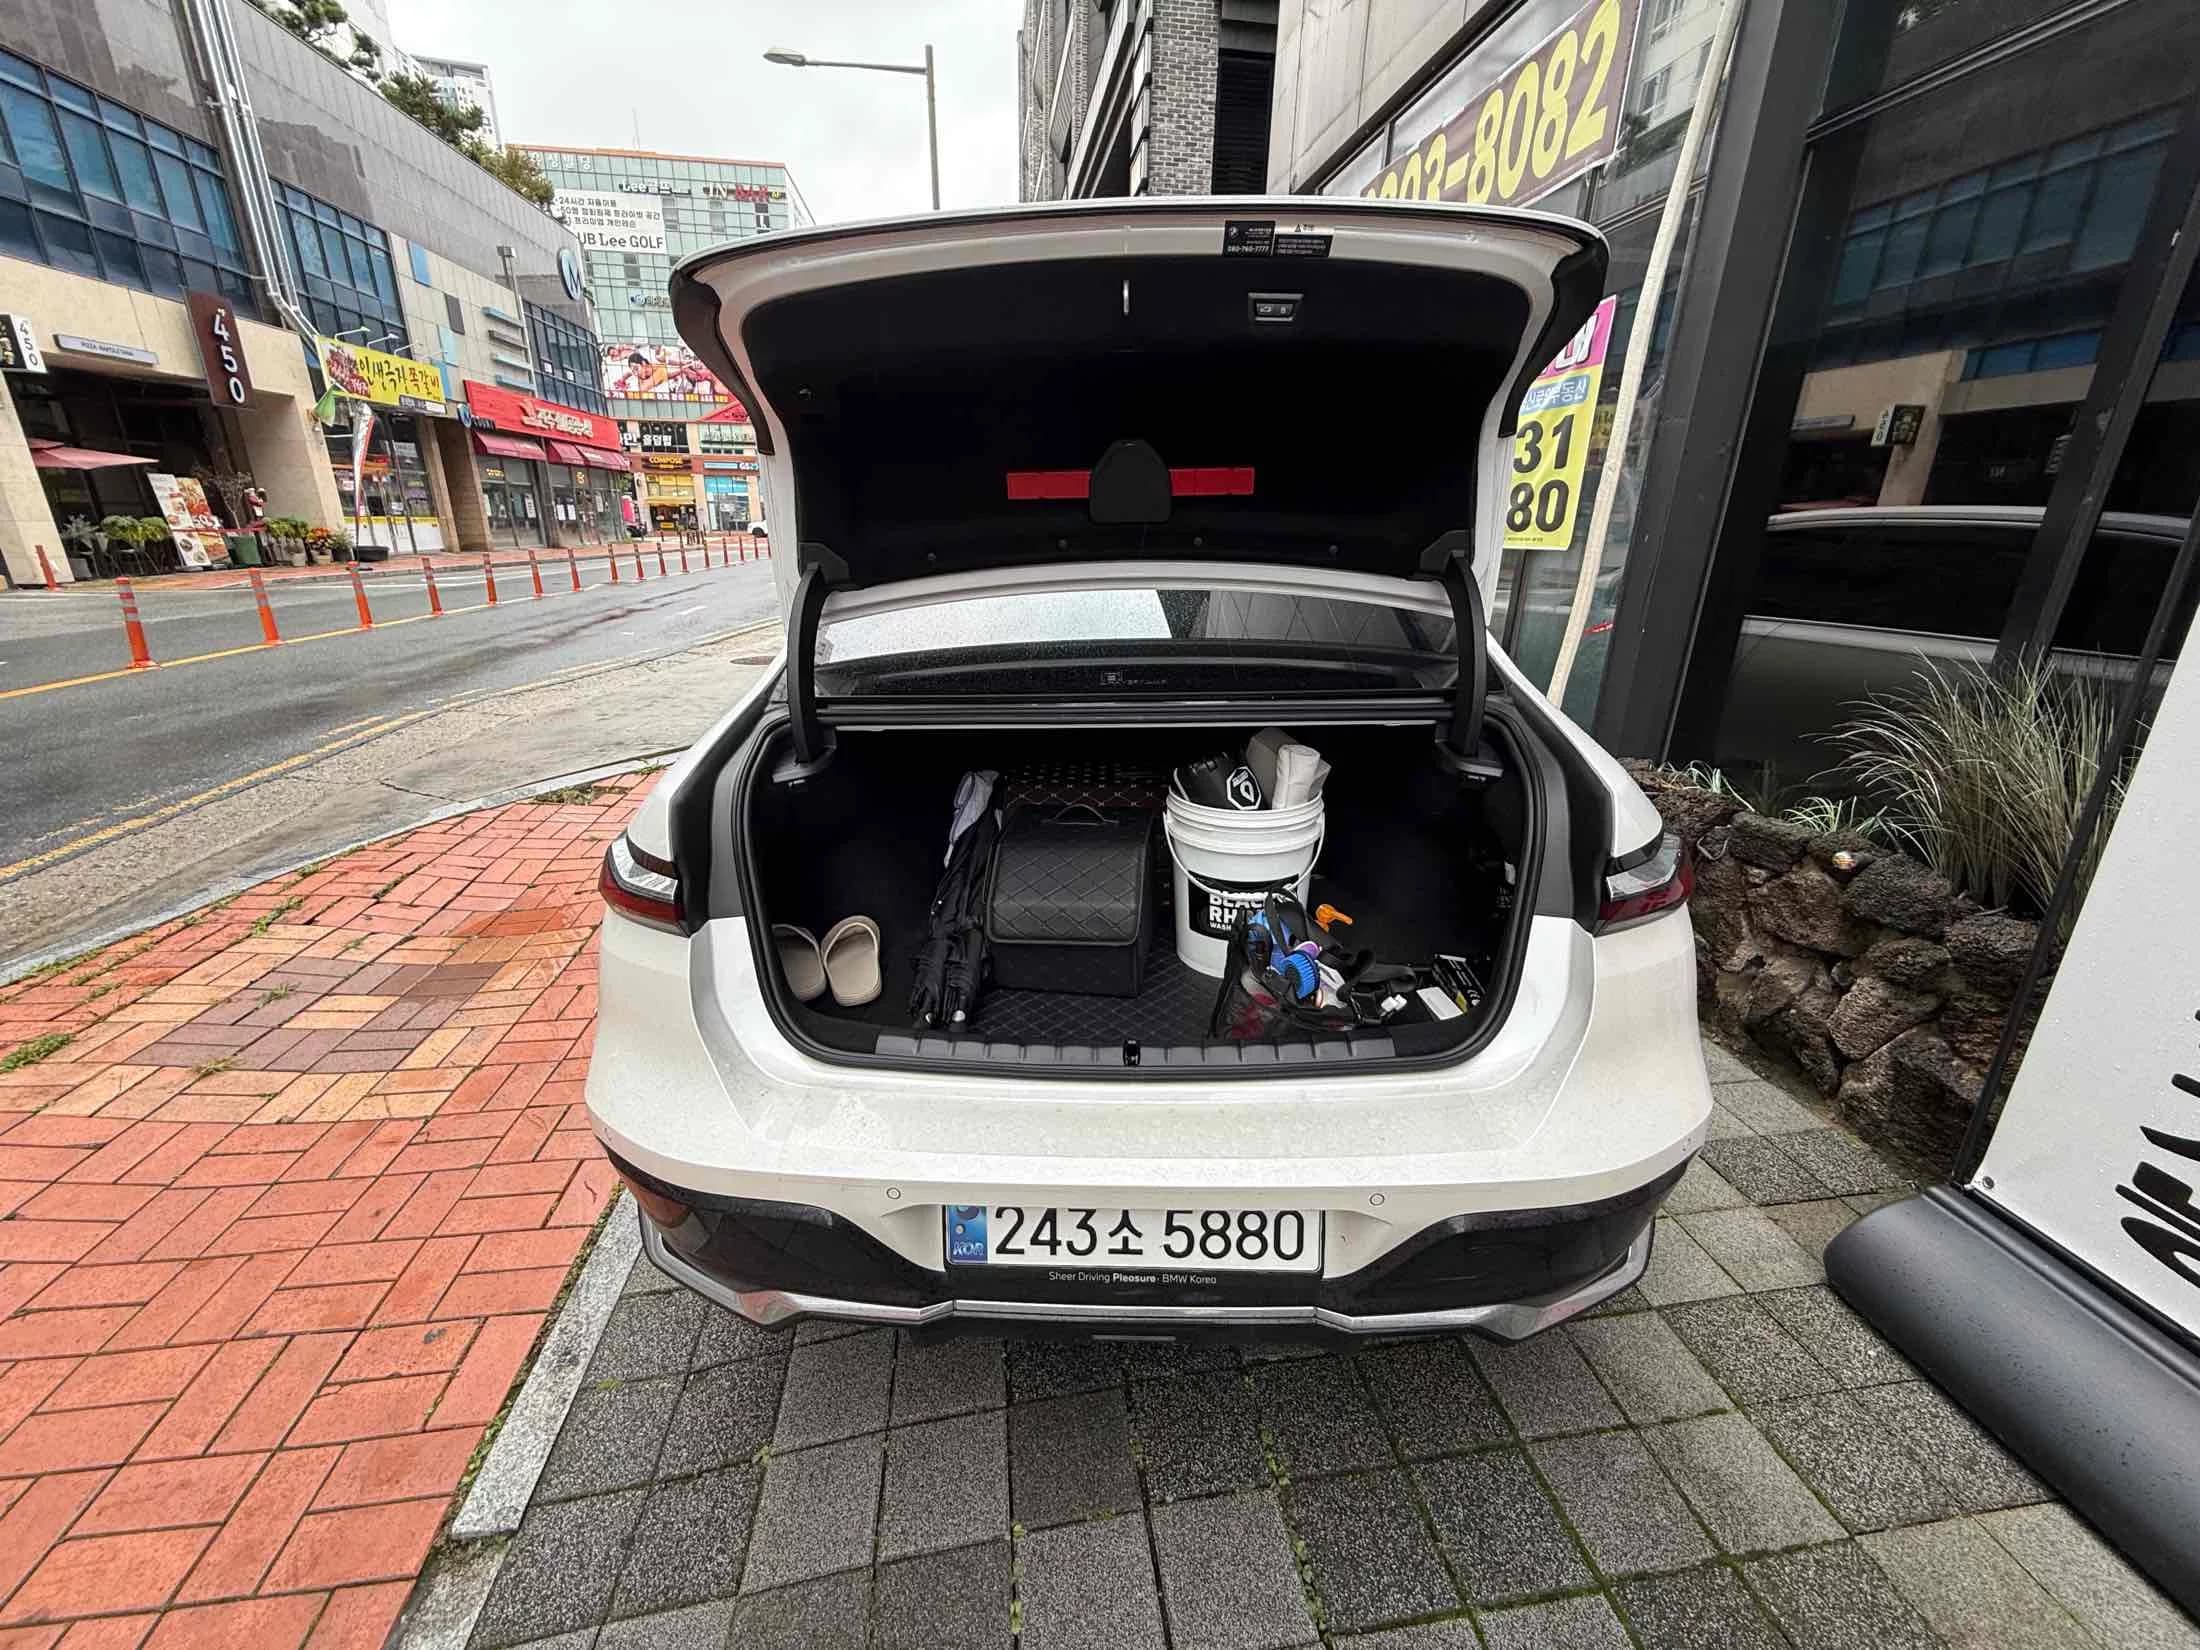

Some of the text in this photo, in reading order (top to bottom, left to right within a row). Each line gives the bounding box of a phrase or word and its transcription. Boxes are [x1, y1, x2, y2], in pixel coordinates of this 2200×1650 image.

[598, 233, 627, 248] Lee
[629, 235, 664, 249] GOLF
[995, 1206, 1305, 1260] 243소 5880
[1048, 1271, 1217, 1285] Sheer Driving Pleasure BMW Korea
